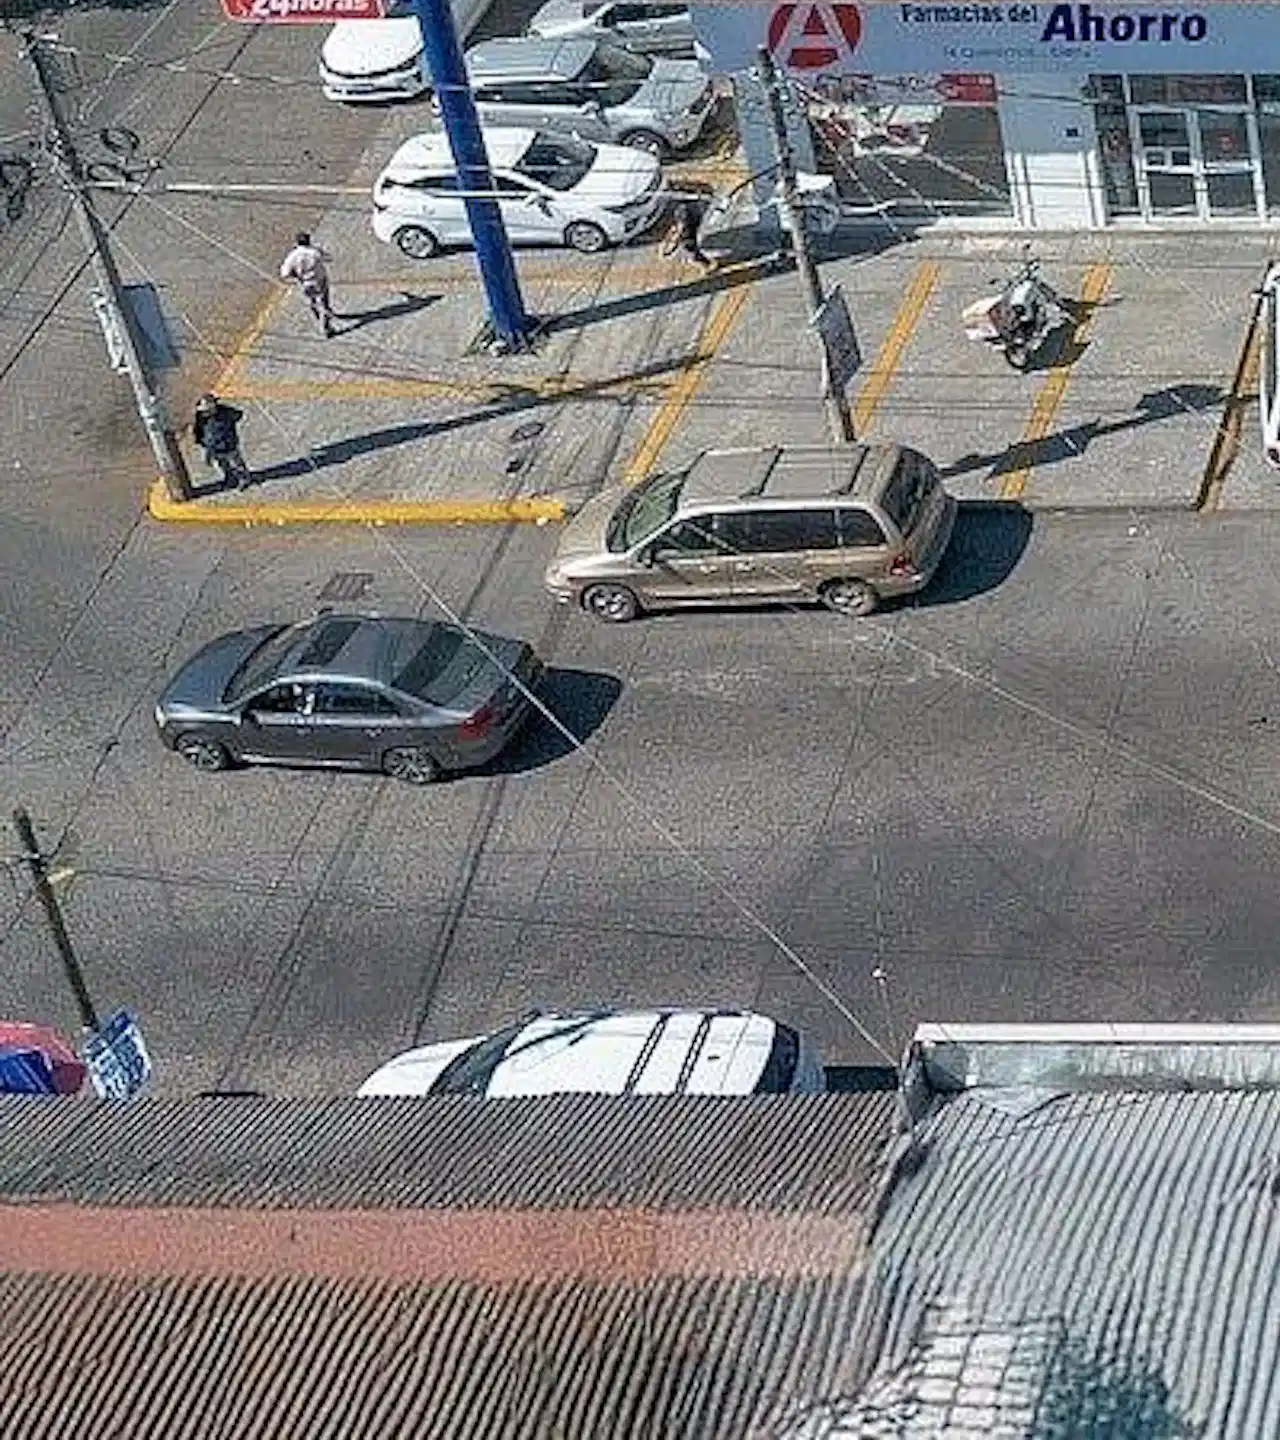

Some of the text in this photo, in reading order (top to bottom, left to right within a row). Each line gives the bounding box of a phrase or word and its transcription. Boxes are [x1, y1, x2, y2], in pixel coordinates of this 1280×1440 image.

[901, 4, 1207, 42] Farmacias del Ahorro
